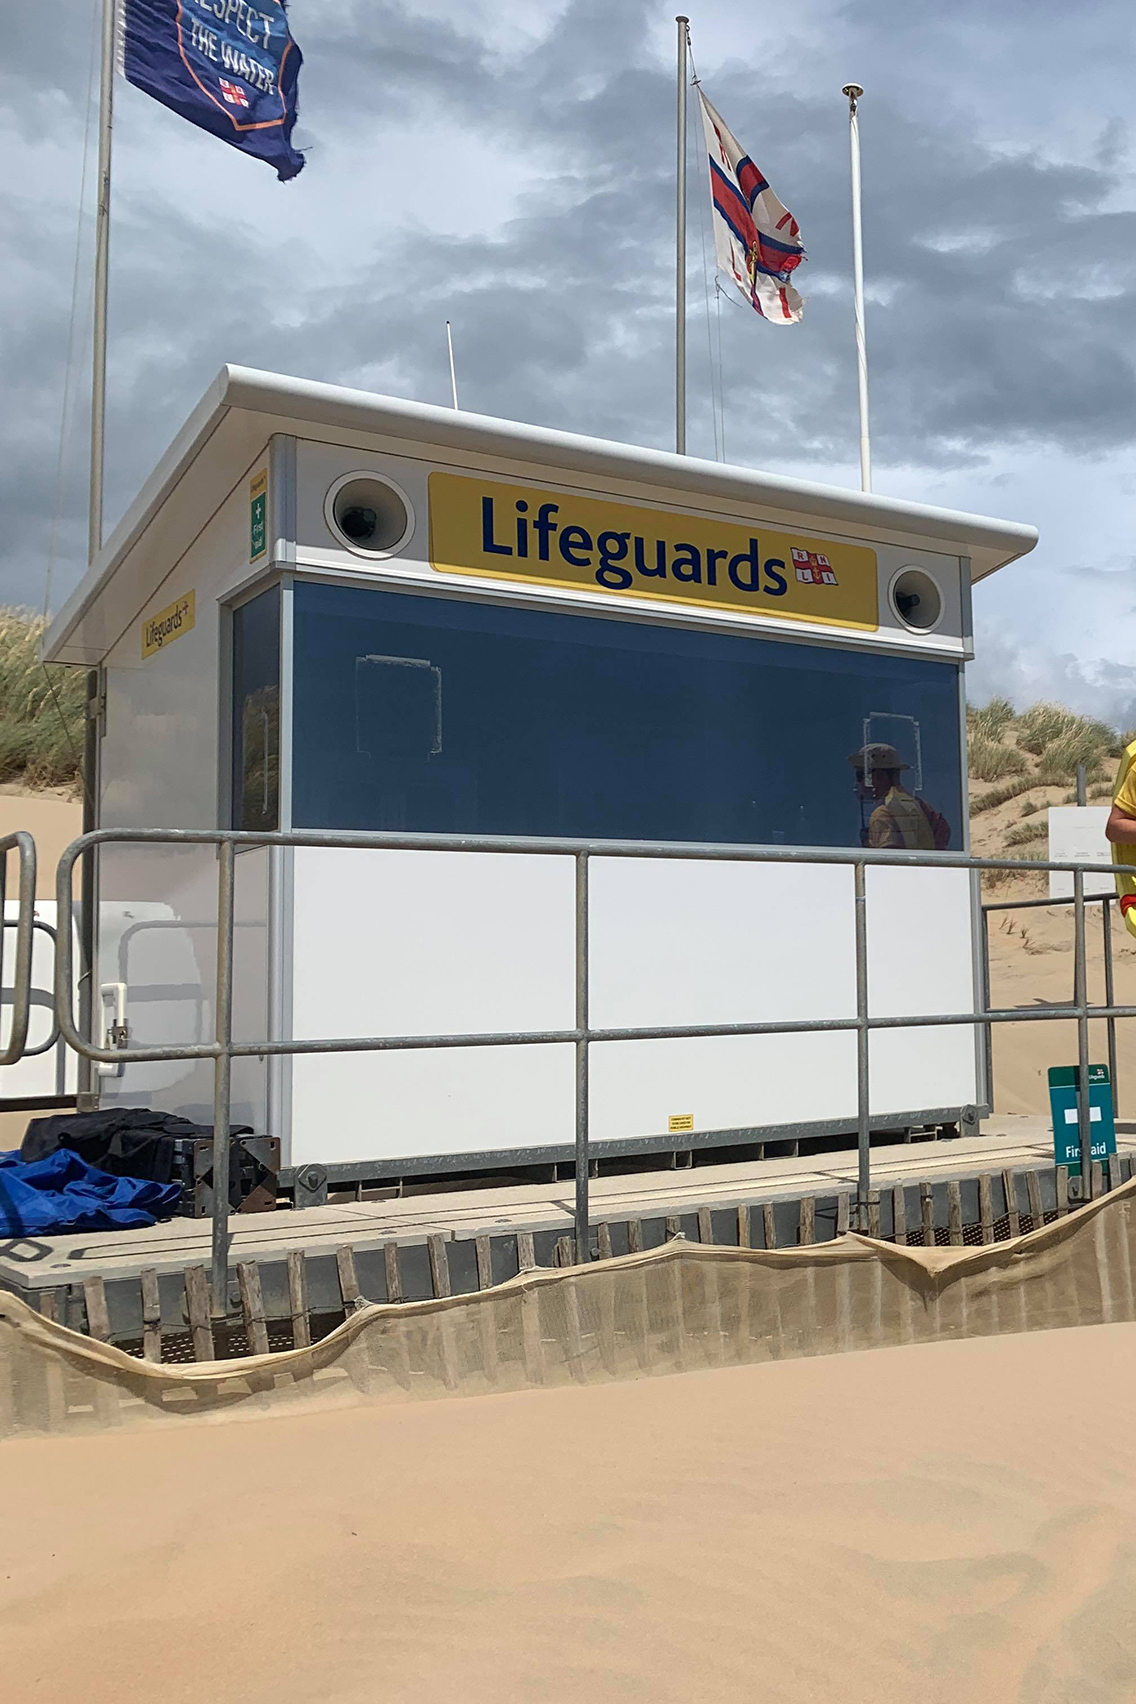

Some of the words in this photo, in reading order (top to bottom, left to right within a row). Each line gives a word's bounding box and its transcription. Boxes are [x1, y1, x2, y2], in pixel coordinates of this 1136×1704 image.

[195, 0, 274, 49] SPECT
[191, 18, 218, 61] THE
[221, 41, 274, 95] WATER
[482, 496, 788, 597] Lifeguards
[146, 605, 182, 647] Lifeguards
[1091, 1141, 1106, 1155] aid
